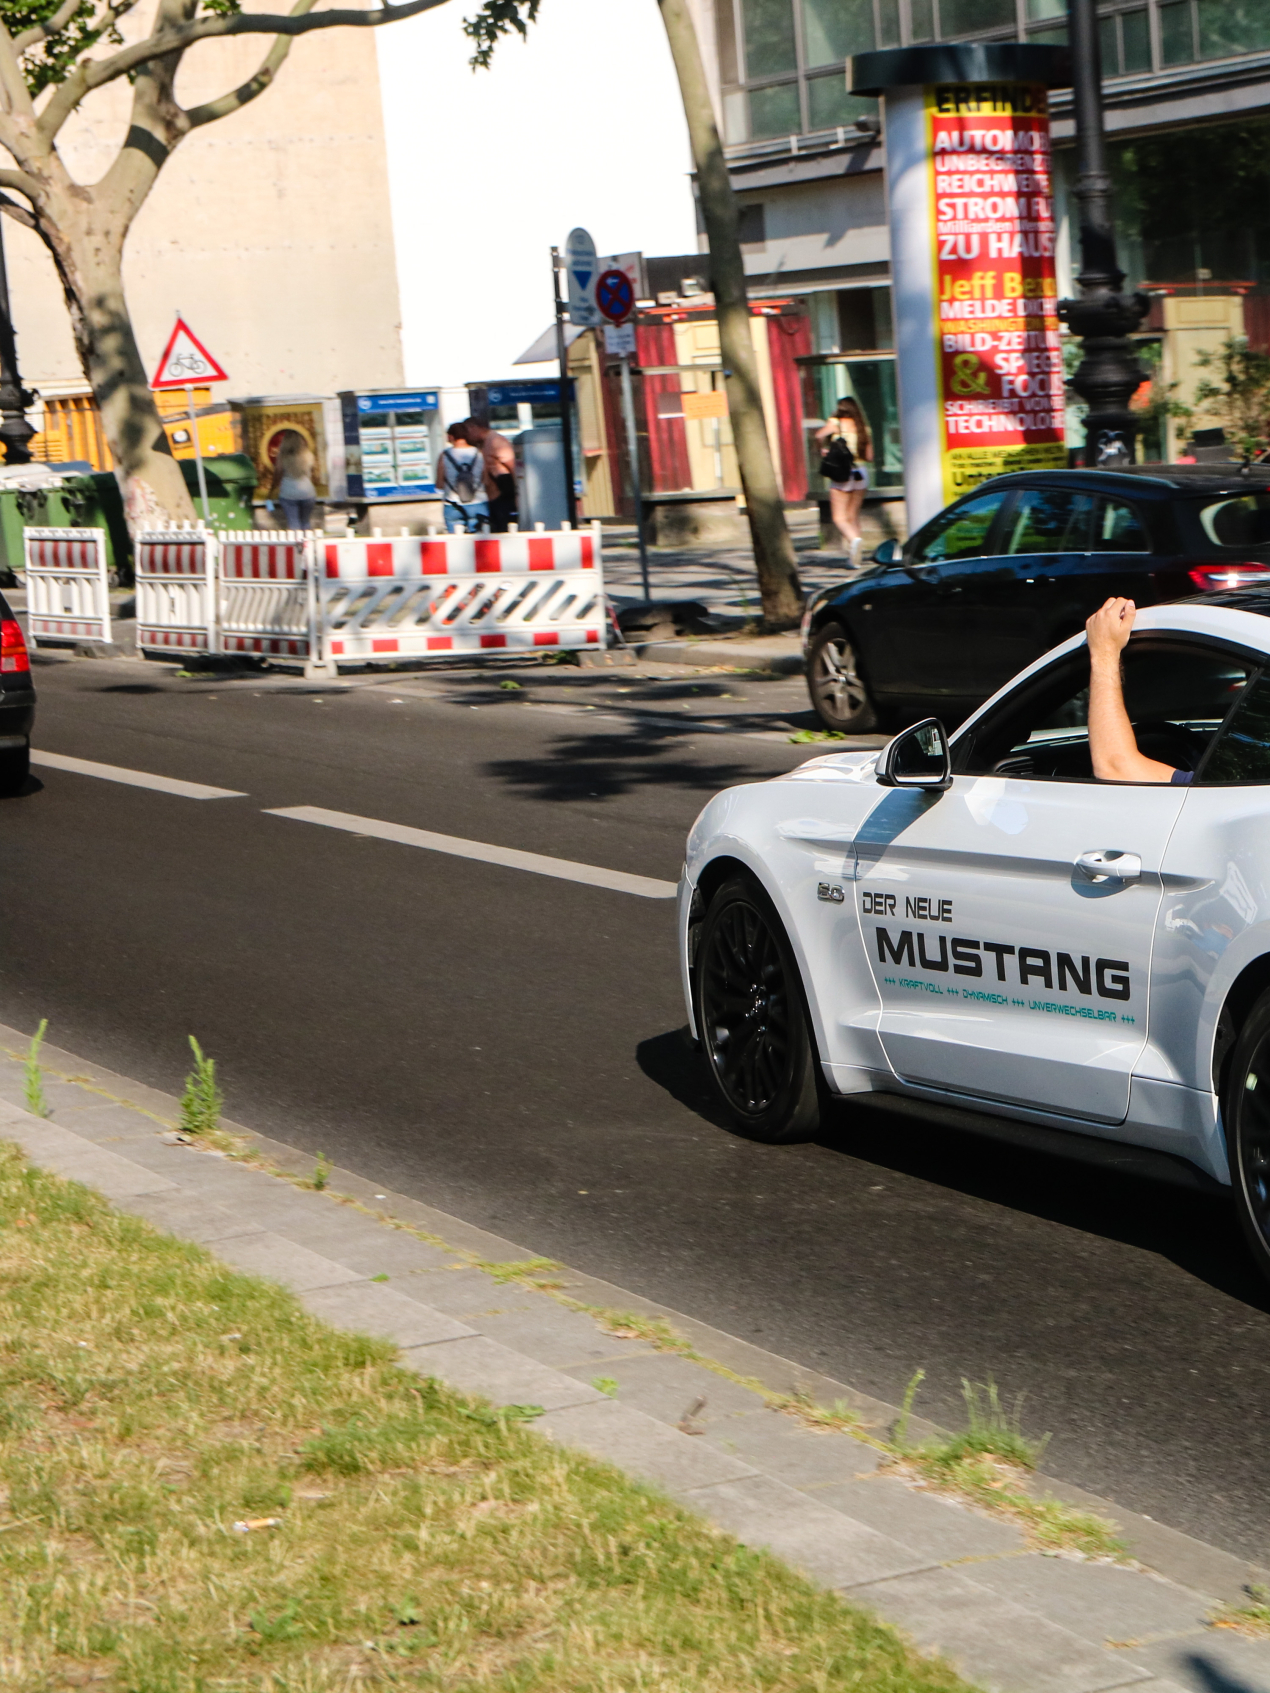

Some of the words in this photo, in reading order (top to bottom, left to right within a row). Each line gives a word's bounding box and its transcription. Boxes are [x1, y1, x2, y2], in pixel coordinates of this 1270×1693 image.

[938, 196, 1028, 220] STROM
[938, 234, 980, 260] ZU
[940, 271, 997, 300] Jeff
[941, 298, 1014, 319] MELDE
[862, 891, 896, 916] DER
[905, 896, 953, 923] NEUE
[875, 926, 1130, 1001] MUSTANG
[899, 978, 943, 995] KRAFTVOLL
[963, 989, 1008, 1006] DYNAMISCH
[1029, 1000, 1116, 1023] UNVERWECHSELBAR
